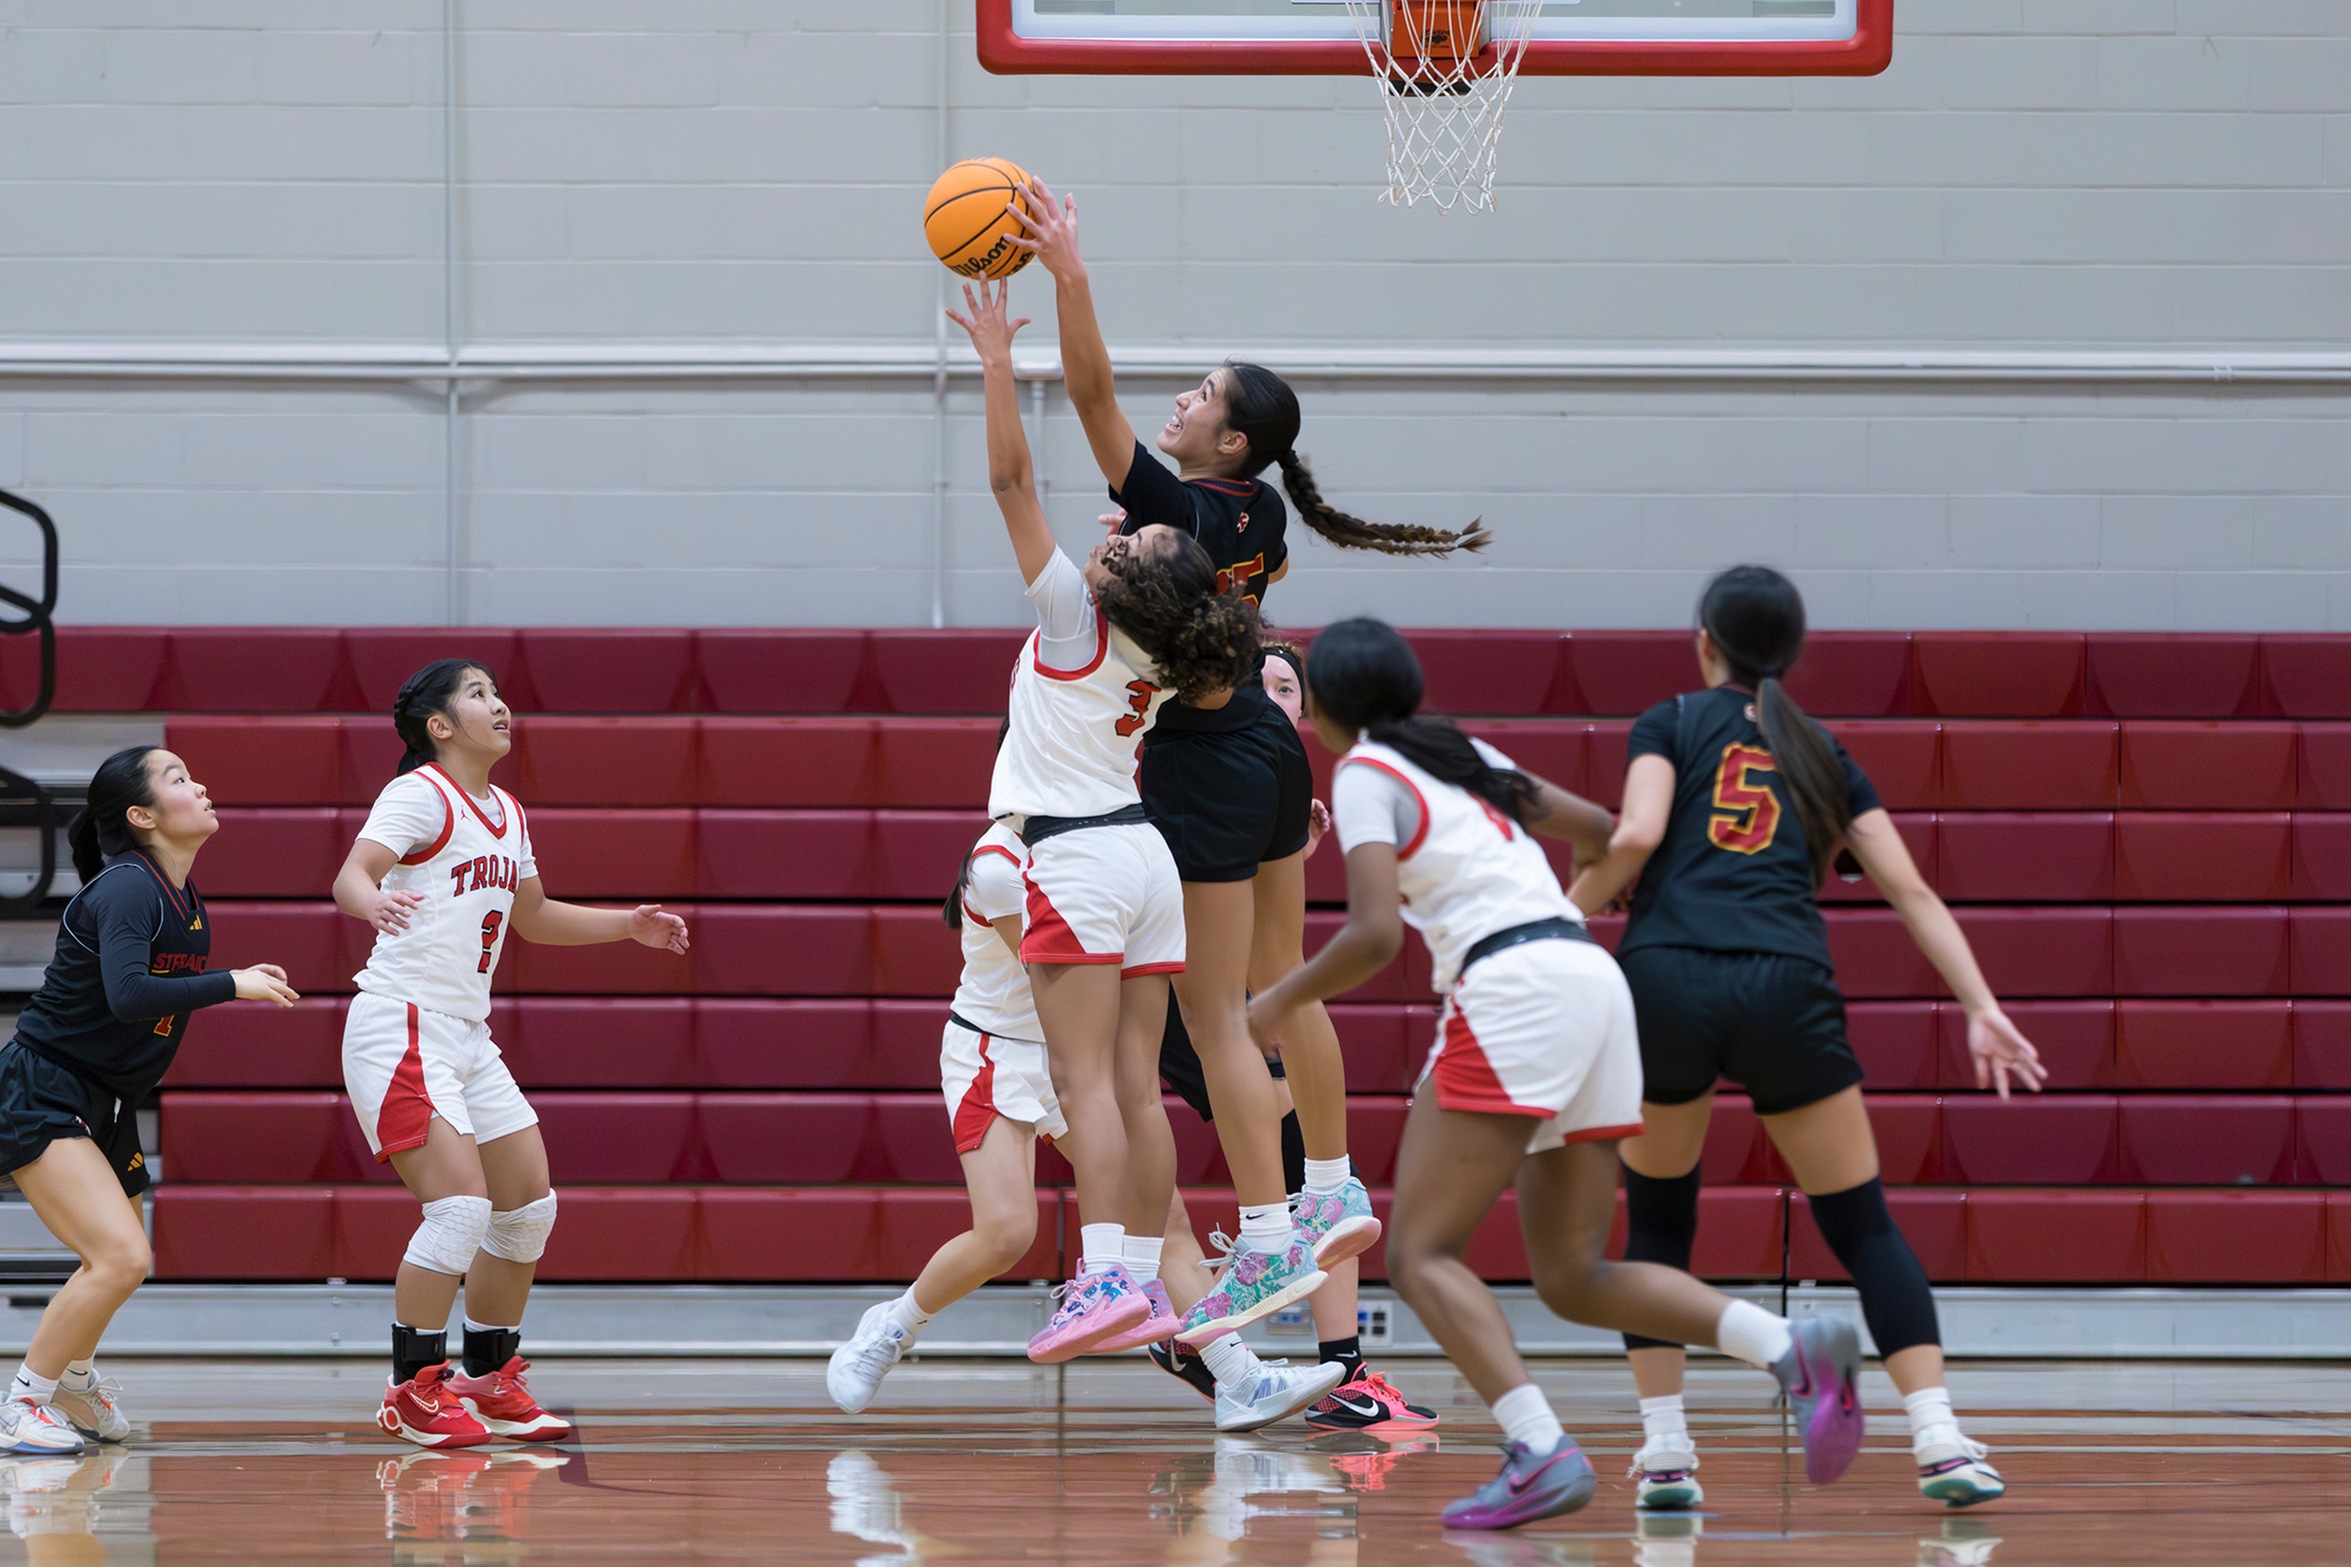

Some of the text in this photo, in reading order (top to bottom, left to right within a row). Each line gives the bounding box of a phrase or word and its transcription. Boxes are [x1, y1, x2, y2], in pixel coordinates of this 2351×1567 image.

[949, 236, 1010, 276] Wilson
[1707, 742, 1781, 855] 5
[477, 910, 503, 974] 2
